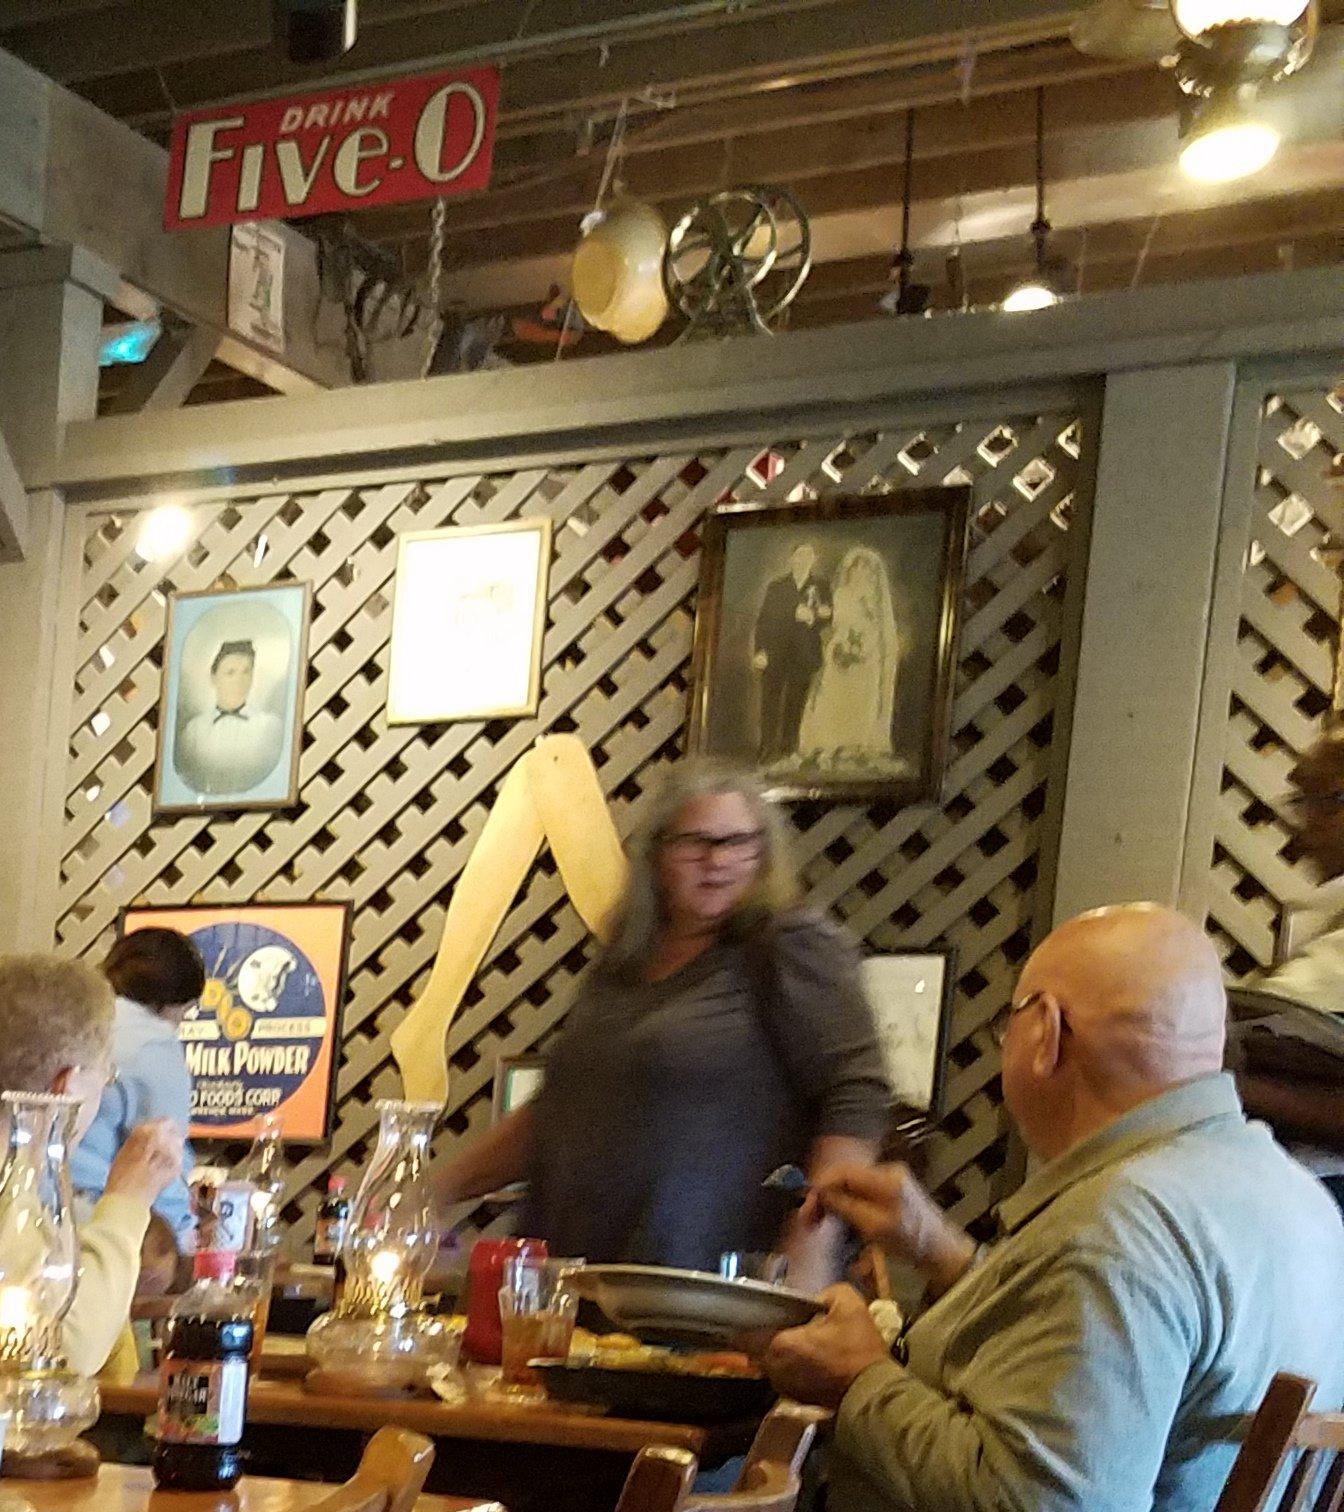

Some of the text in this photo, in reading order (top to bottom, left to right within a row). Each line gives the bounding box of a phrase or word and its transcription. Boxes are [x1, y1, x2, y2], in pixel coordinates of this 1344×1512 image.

[279, 91, 395, 134] DRINK
[185, 1041, 310, 1076] MILK POWDER
